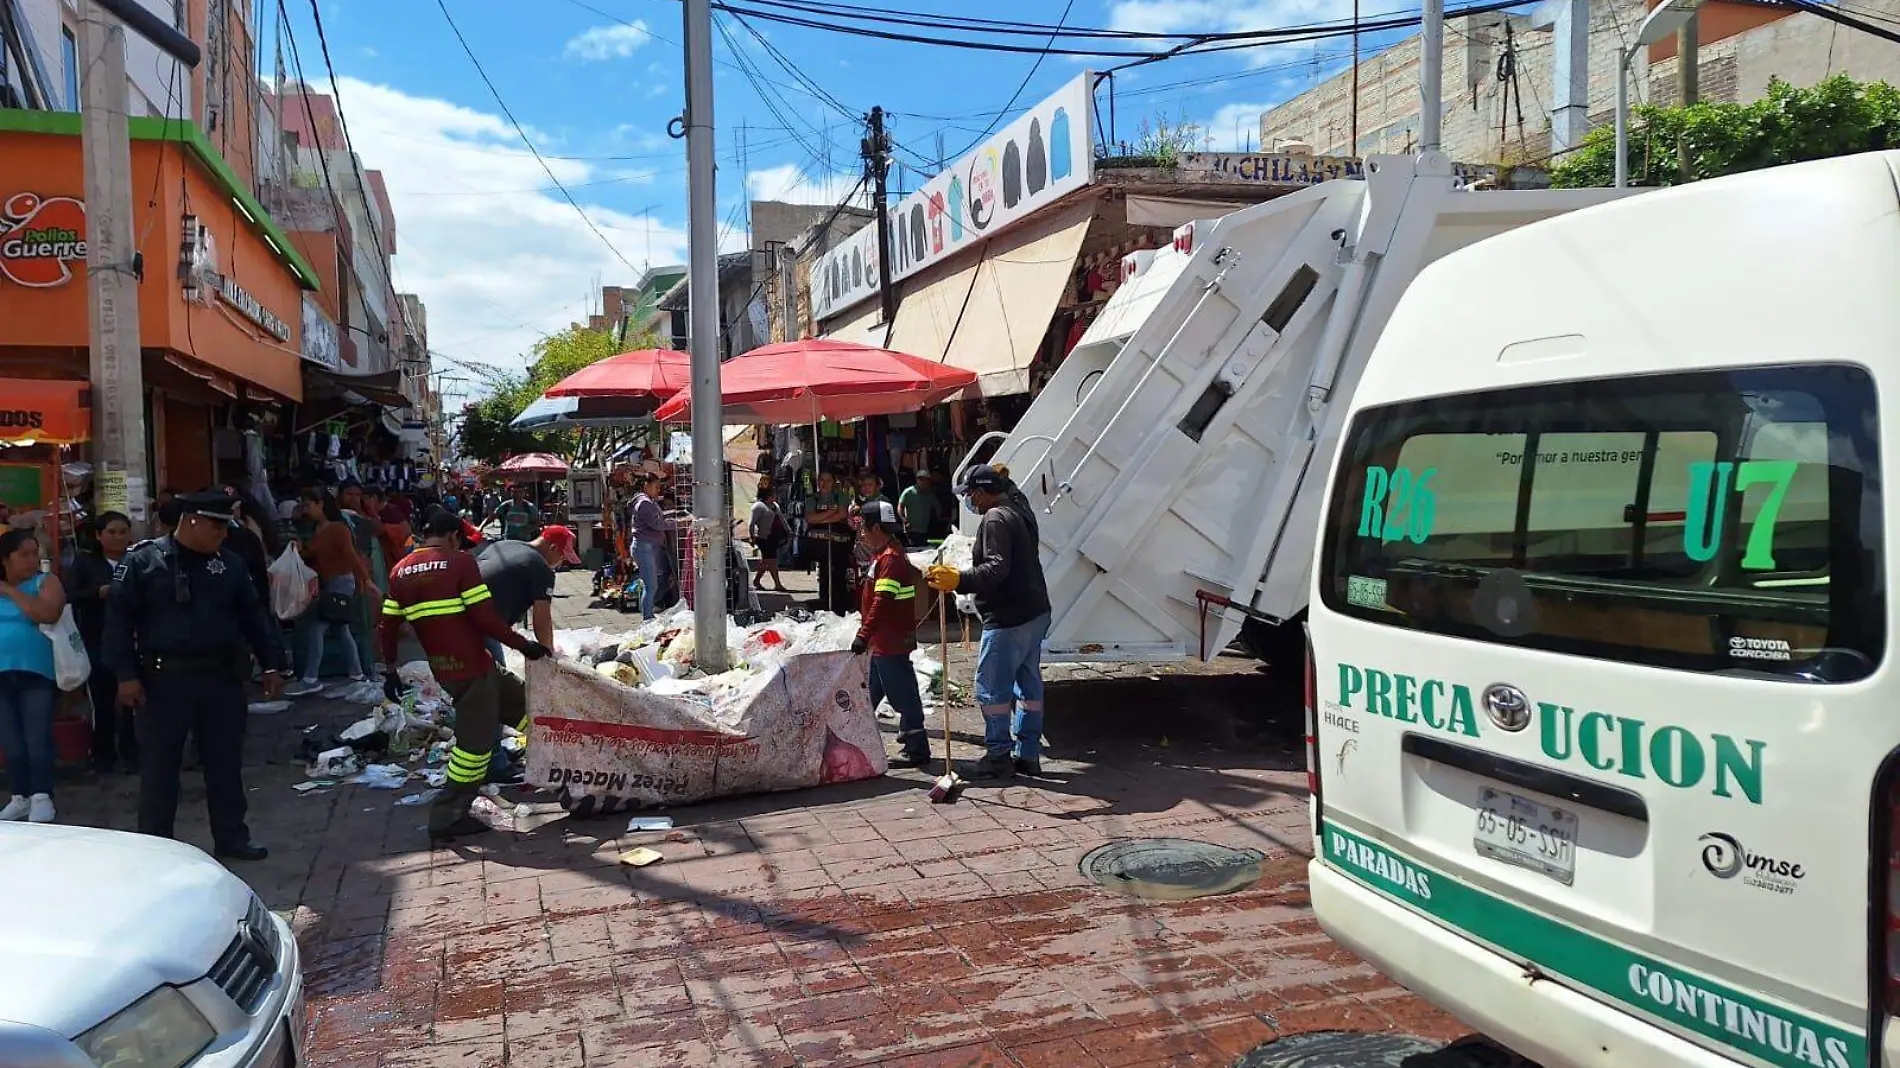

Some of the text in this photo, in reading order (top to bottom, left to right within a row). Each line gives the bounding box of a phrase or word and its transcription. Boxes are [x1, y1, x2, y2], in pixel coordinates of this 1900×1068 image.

[25, 228, 76, 242] Pollos
[1561, 452, 1568, 463] a
[1572, 450, 1617, 462] nuestra
[1358, 466, 1438, 545] R26
[1729, 648, 1791, 661] CORDOBA
[1746, 639, 1790, 650] TOYOTA
[1324, 711, 1360, 733] HIACE
[1338, 663, 1767, 805] PRECA UCION
[1477, 806, 1572, 863] 65-05-SSH
[1332, 832, 1432, 899] PARADAS
[1628, 963, 1851, 1068] CONTINUAS
